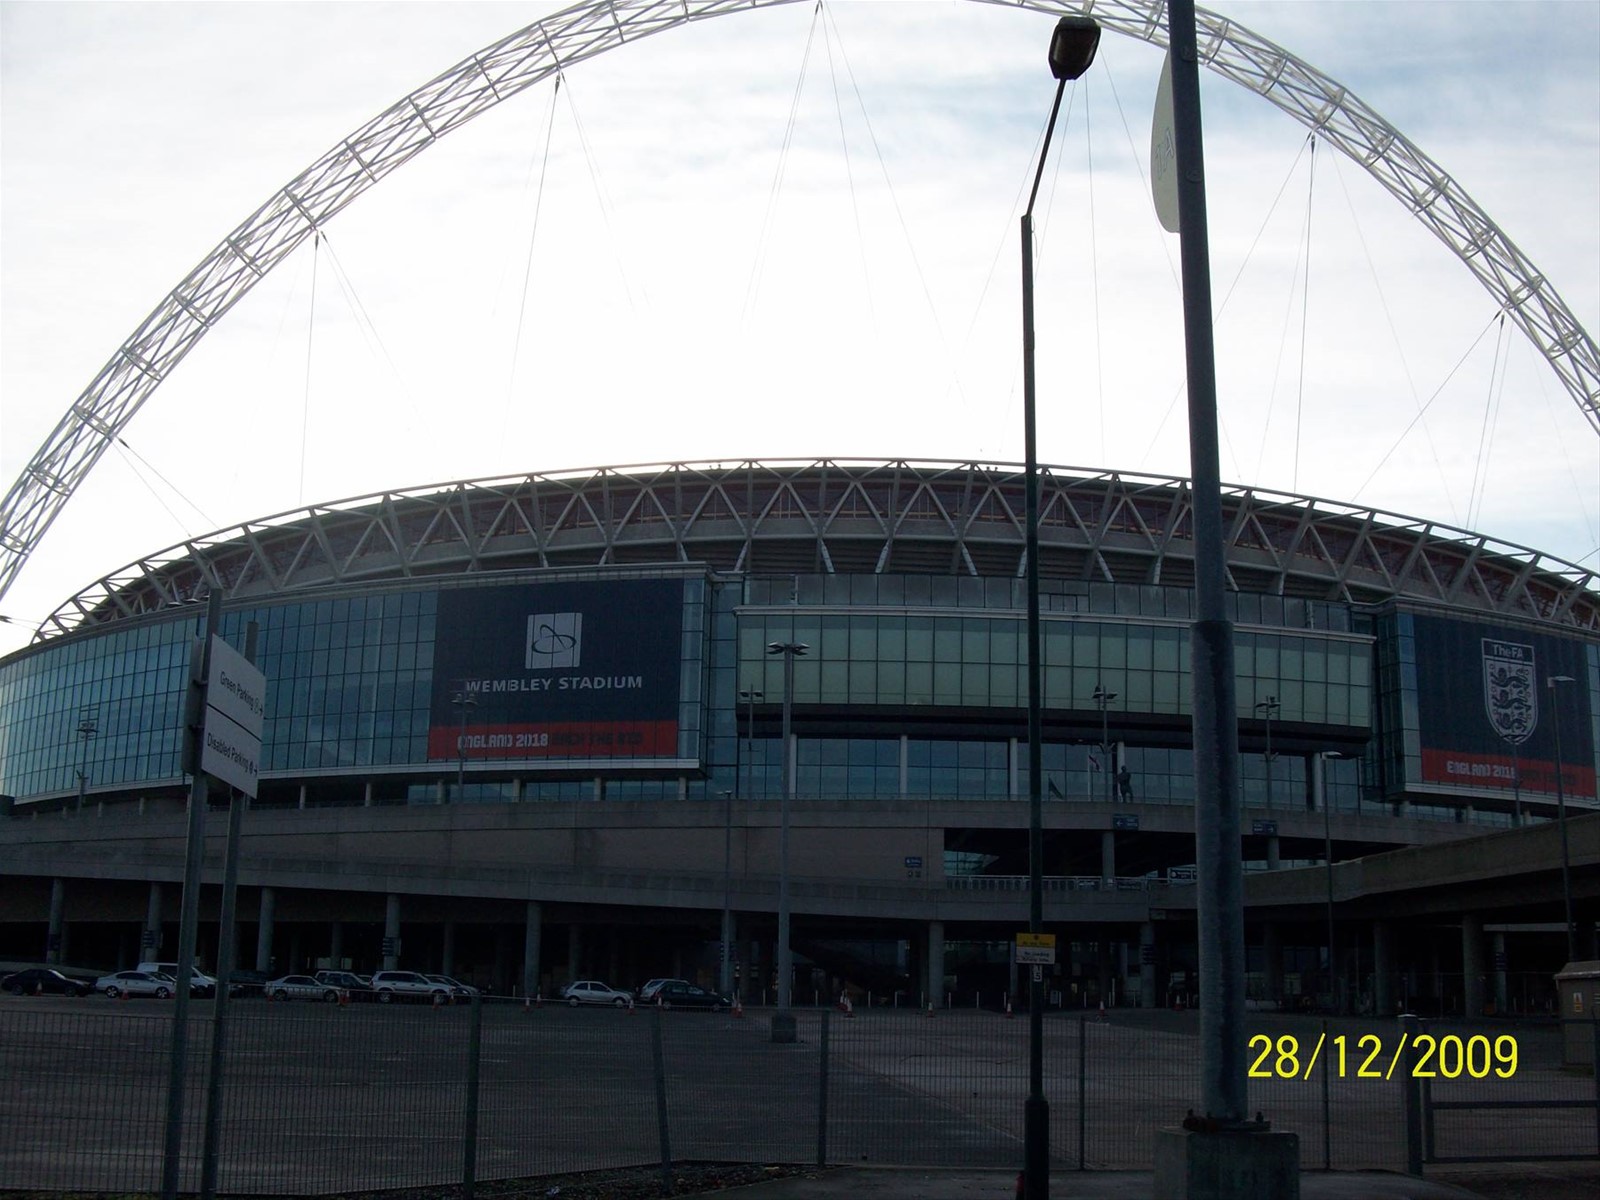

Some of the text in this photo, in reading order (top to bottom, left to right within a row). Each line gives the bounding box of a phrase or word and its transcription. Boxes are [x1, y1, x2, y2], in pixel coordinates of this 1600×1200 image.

[220, 671, 254, 711] Green Parking
[466, 676, 643, 692] WEMBLEY STADIUM
[515, 732, 549, 748] 2018
[207, 732, 249, 773] Disabled Parking
[1446, 760, 1491, 777] ENGLAND
